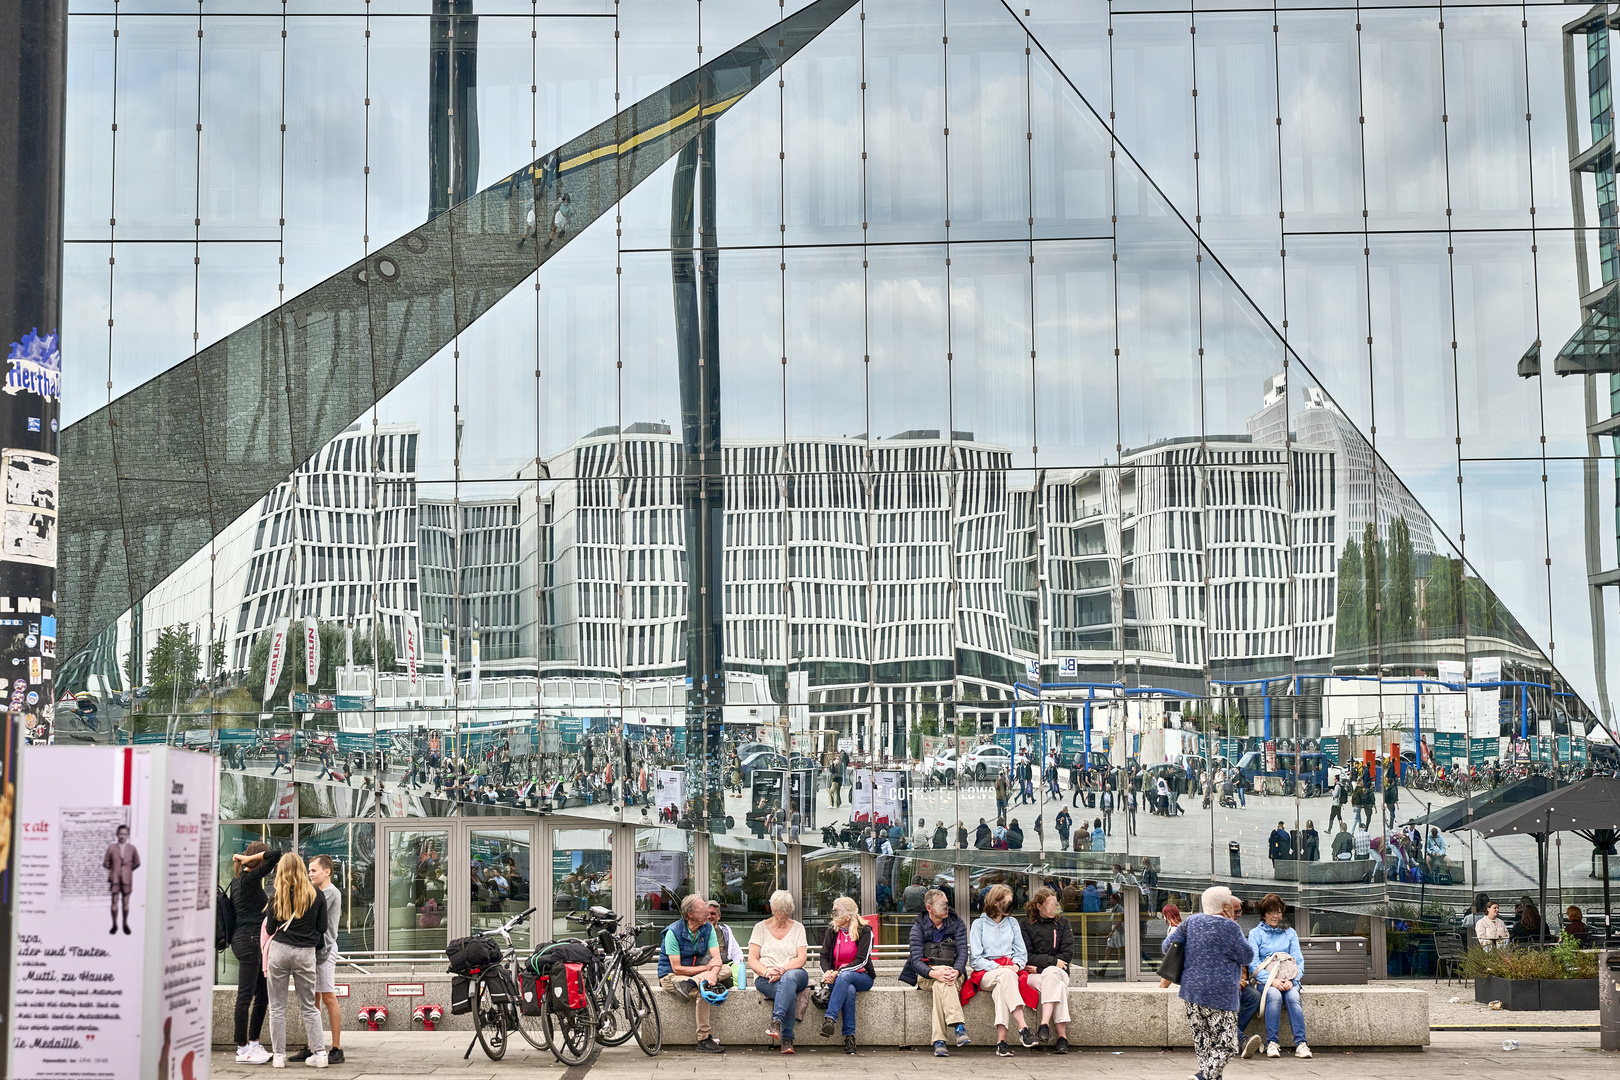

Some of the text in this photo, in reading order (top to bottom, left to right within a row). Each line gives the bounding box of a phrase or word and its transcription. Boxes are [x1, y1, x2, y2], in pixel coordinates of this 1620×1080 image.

[889, 786, 996, 800] COFFEE FELOWS
[44, 945, 67, 956] und
[61, 973, 78, 981] zu
[79, 970, 115, 982] Hause
